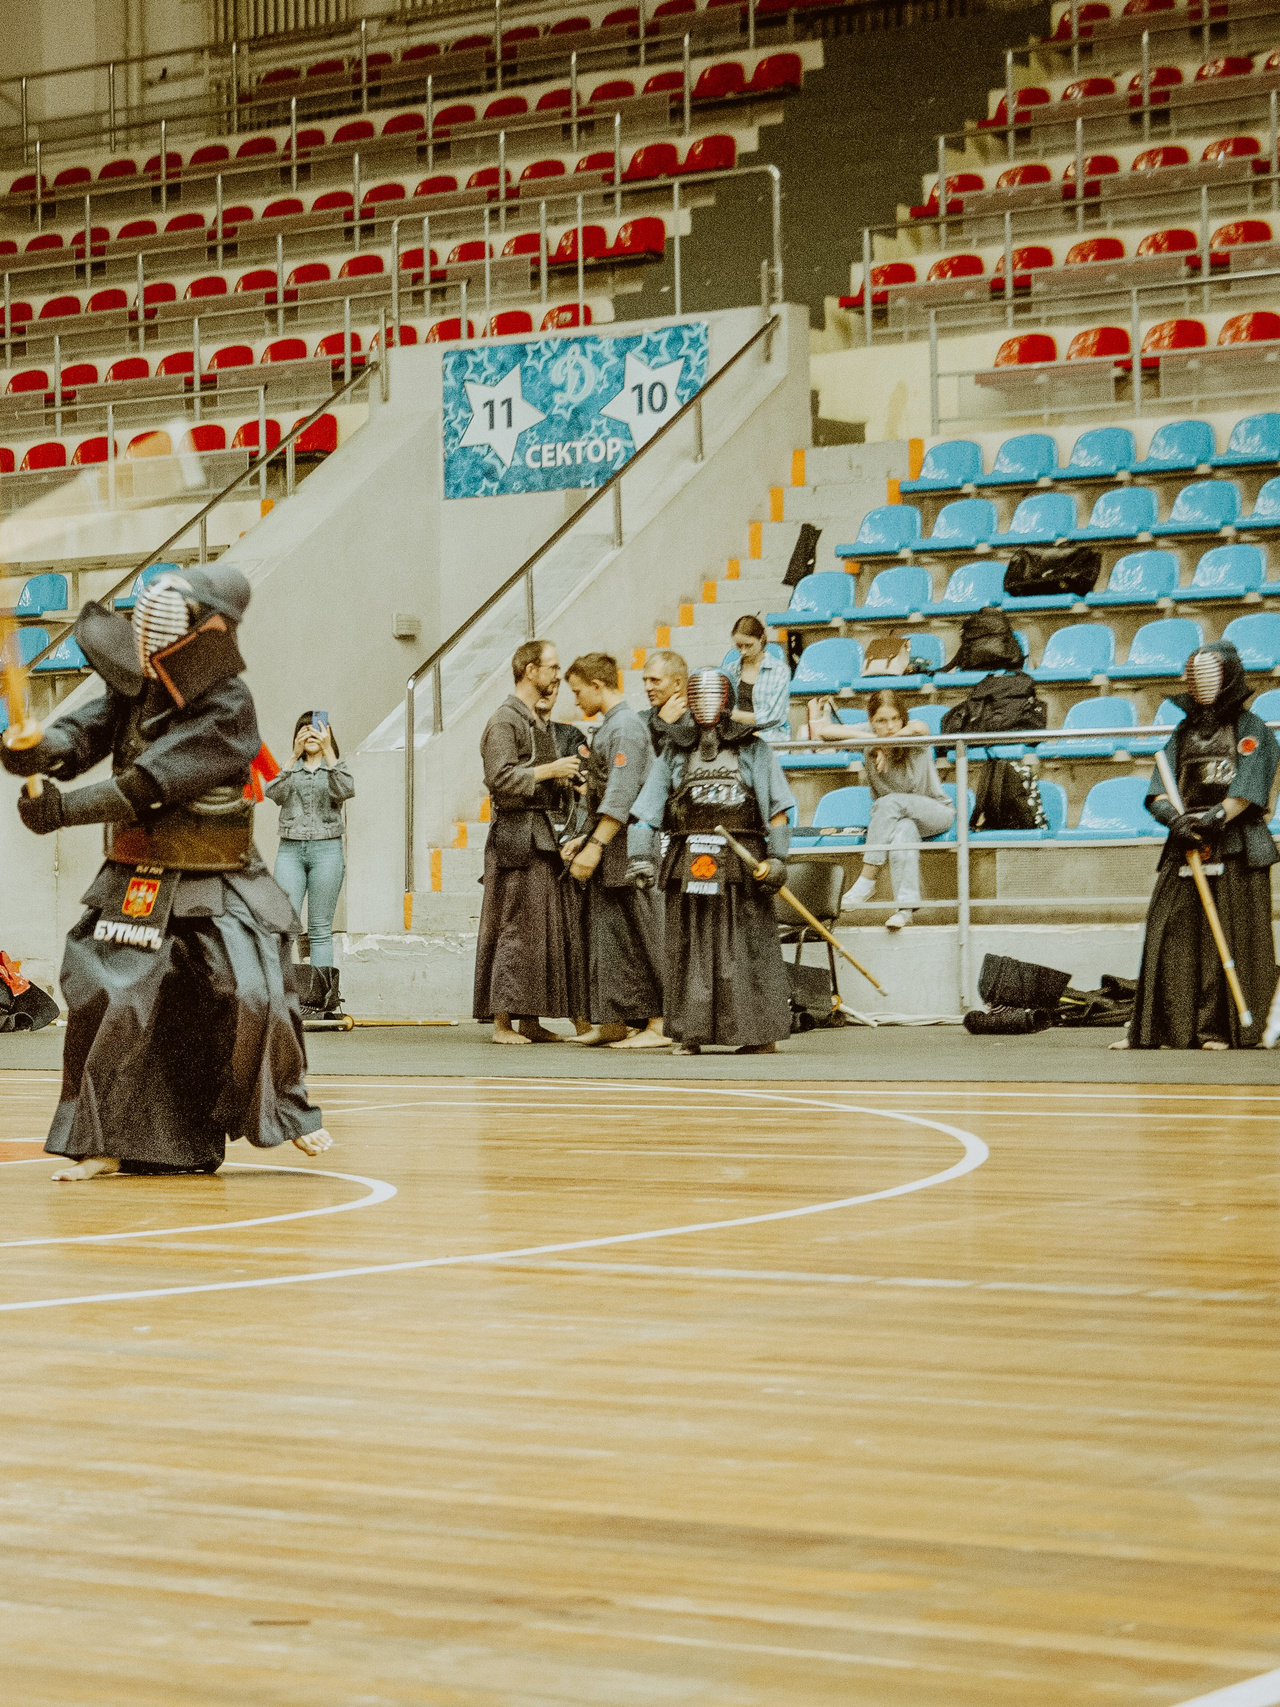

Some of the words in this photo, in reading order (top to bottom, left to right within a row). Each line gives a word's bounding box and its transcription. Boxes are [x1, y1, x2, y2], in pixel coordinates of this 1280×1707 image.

[482, 397, 513, 430] 11
[631, 381, 668, 415] 10
[525, 437, 621, 469] СЕКТОР
[93, 920, 163, 950] БУТНАРЬ
